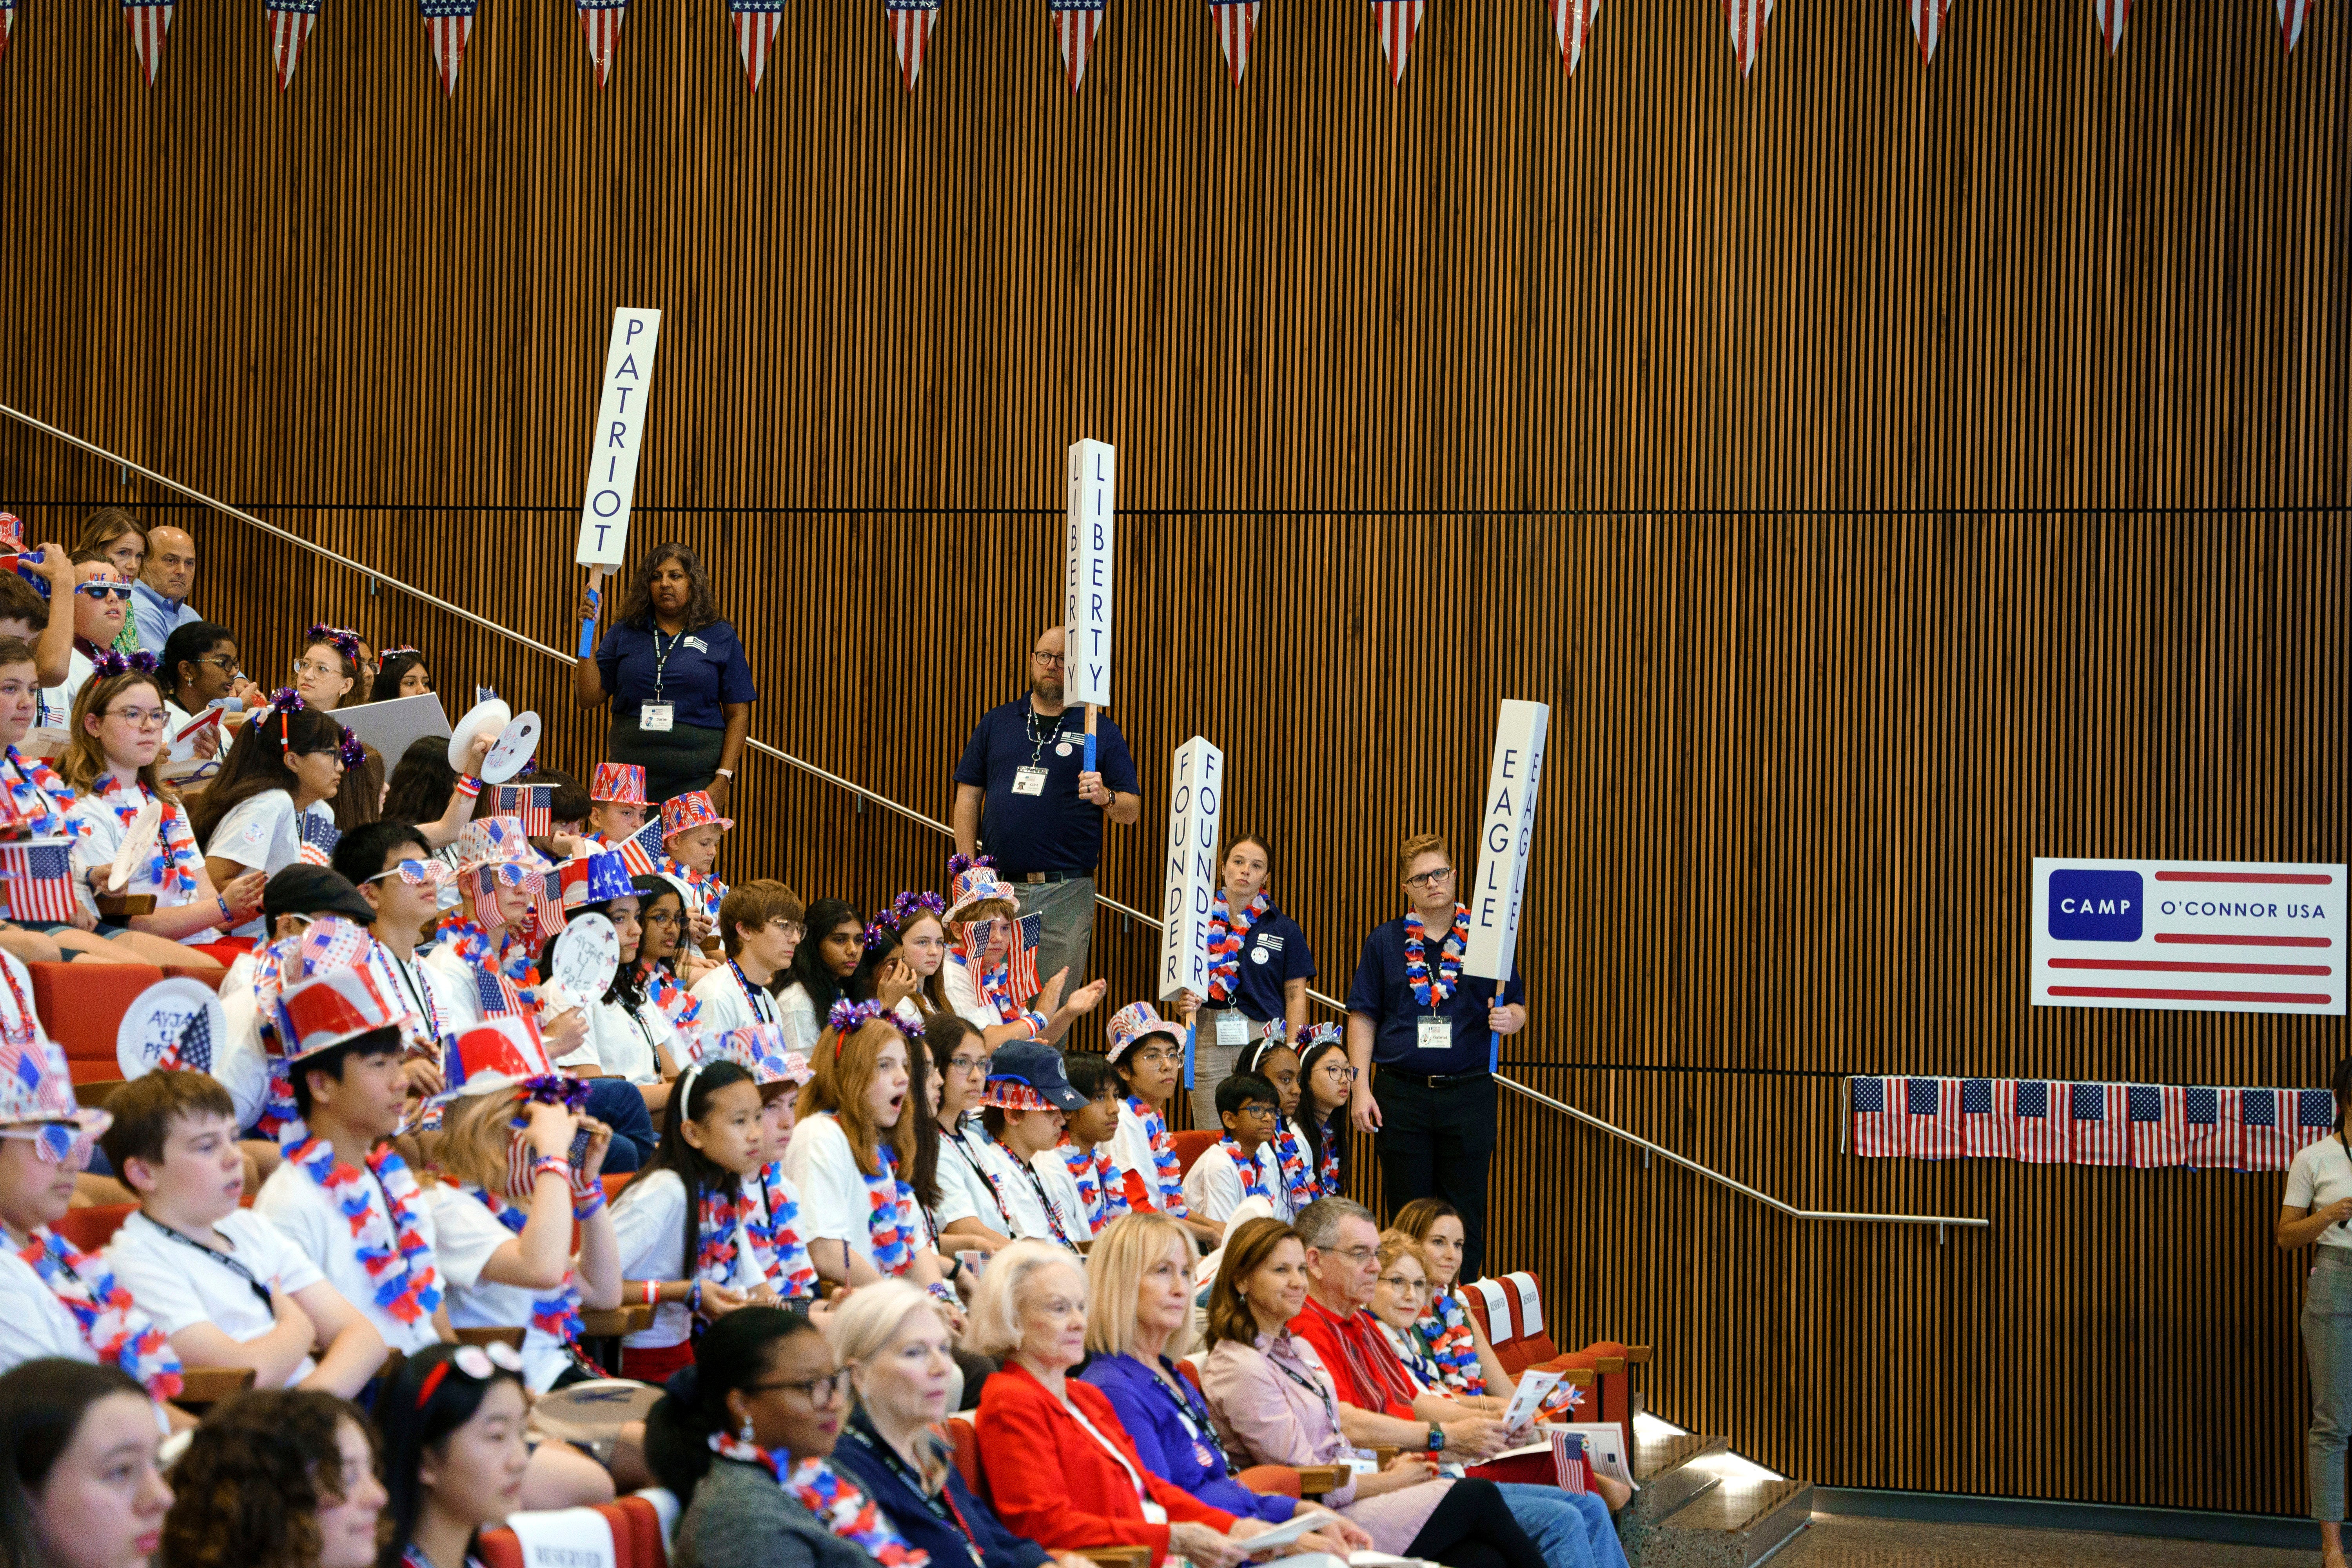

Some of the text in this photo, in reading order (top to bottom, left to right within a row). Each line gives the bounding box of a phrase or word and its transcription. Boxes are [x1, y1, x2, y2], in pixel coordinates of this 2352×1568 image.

[593, 319, 643, 551] PATRIOT
[1068, 455, 1078, 692] LIBERTY
[1089, 454, 1105, 691] LIBERTY
[1167, 752, 1189, 983] FOUNDER
[1194, 753, 1216, 985] FOUNDER
[1481, 750, 1517, 927] EAGLE
[1510, 753, 1539, 931] EAGLE
[2061, 898, 2326, 919] CAMP O'CONNOR USA
[1490, 1298, 1505, 1312] RESERVED
[1524, 1291, 1537, 1305] RESERVED
